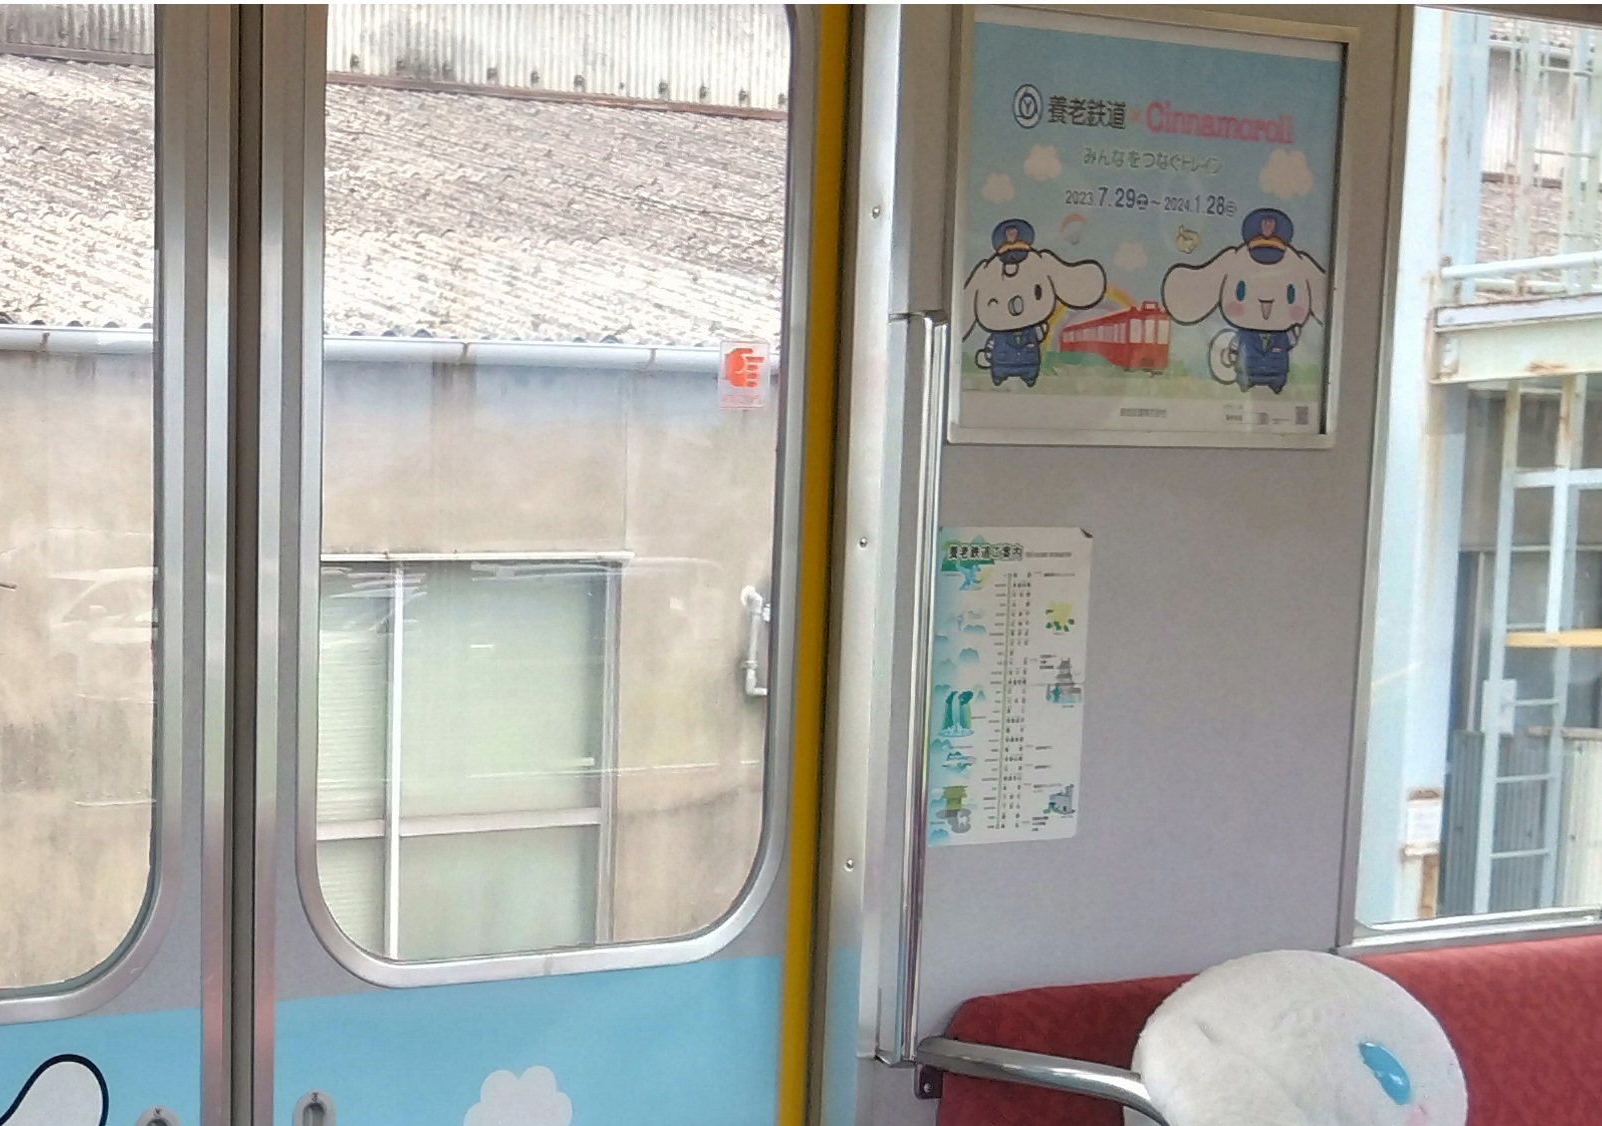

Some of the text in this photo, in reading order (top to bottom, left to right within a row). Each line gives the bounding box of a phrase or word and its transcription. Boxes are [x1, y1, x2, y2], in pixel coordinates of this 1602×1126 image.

[1047, 95, 1127, 130] 養老鉄道
[1145, 100, 1295, 145] Cinnamoroll
